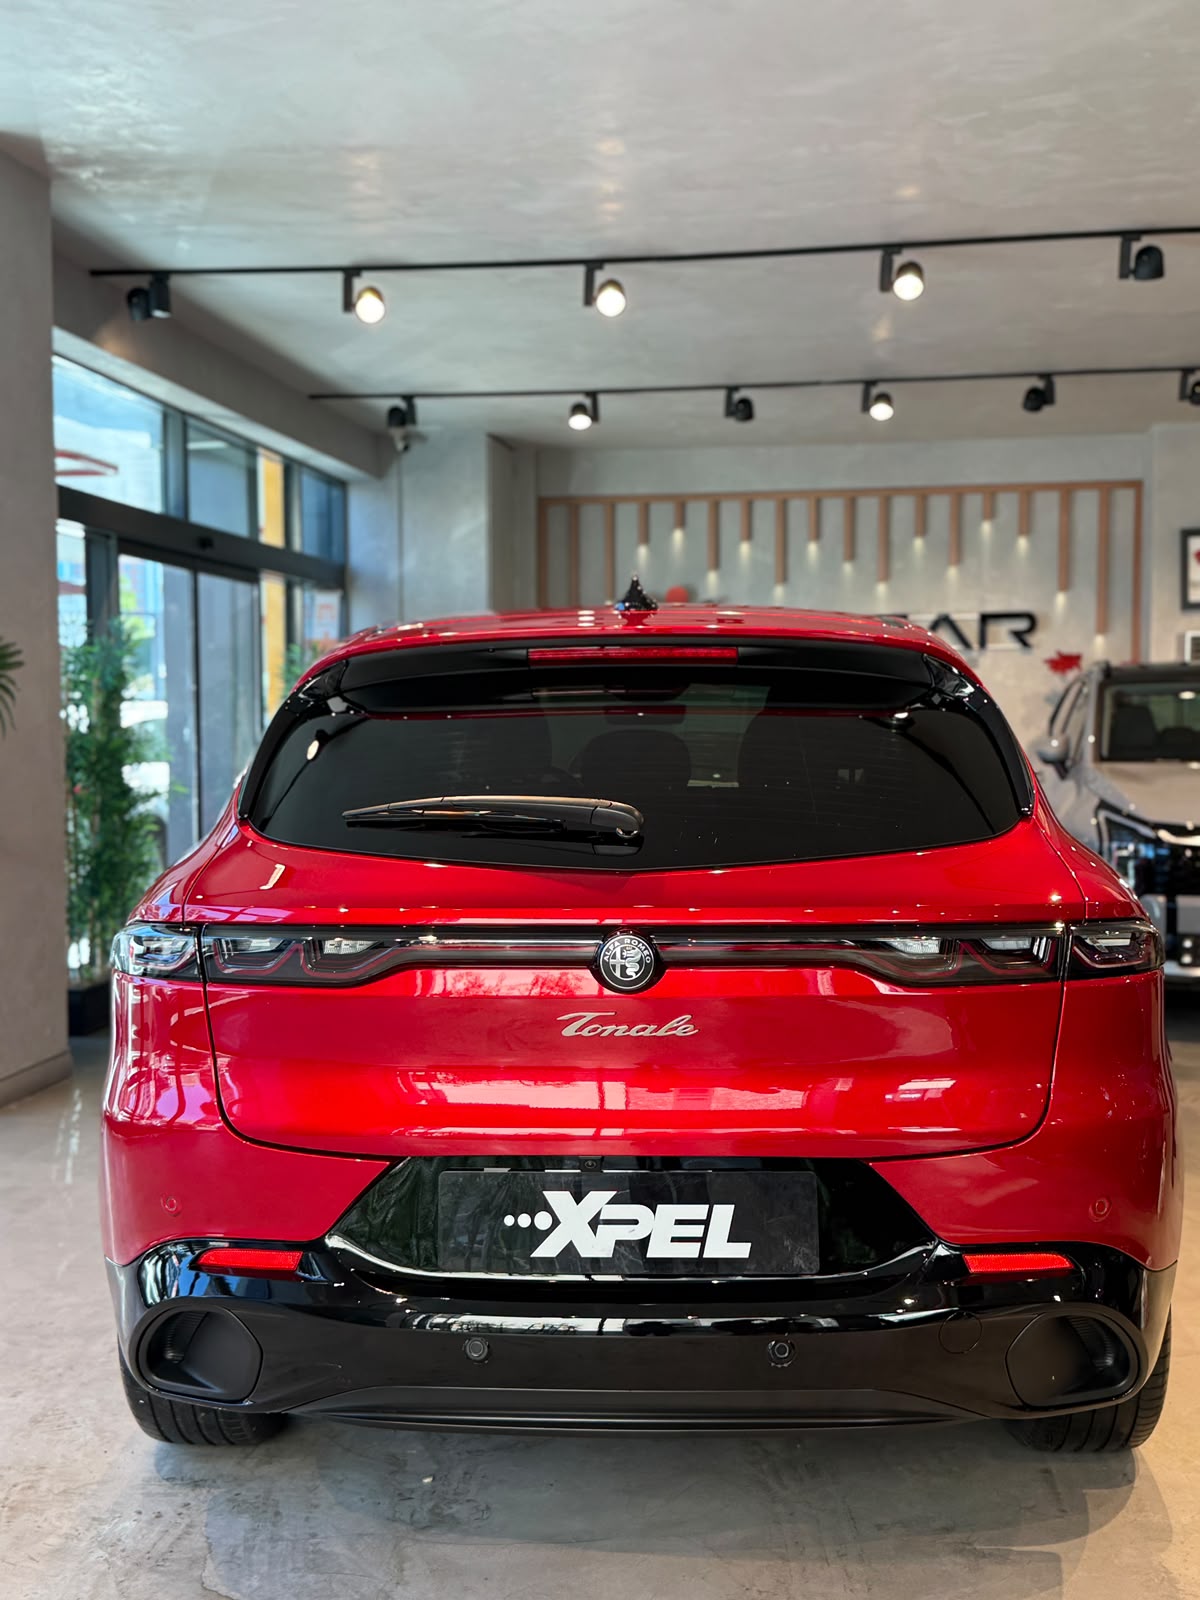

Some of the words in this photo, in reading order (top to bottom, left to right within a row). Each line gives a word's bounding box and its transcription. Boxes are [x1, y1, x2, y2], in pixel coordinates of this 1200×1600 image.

[603, 940, 621, 962] ALFA
[624, 938, 651, 963] ROMEO
[556, 1011, 699, 1037] Tonale
[530, 1190, 751, 1258] XPEL
